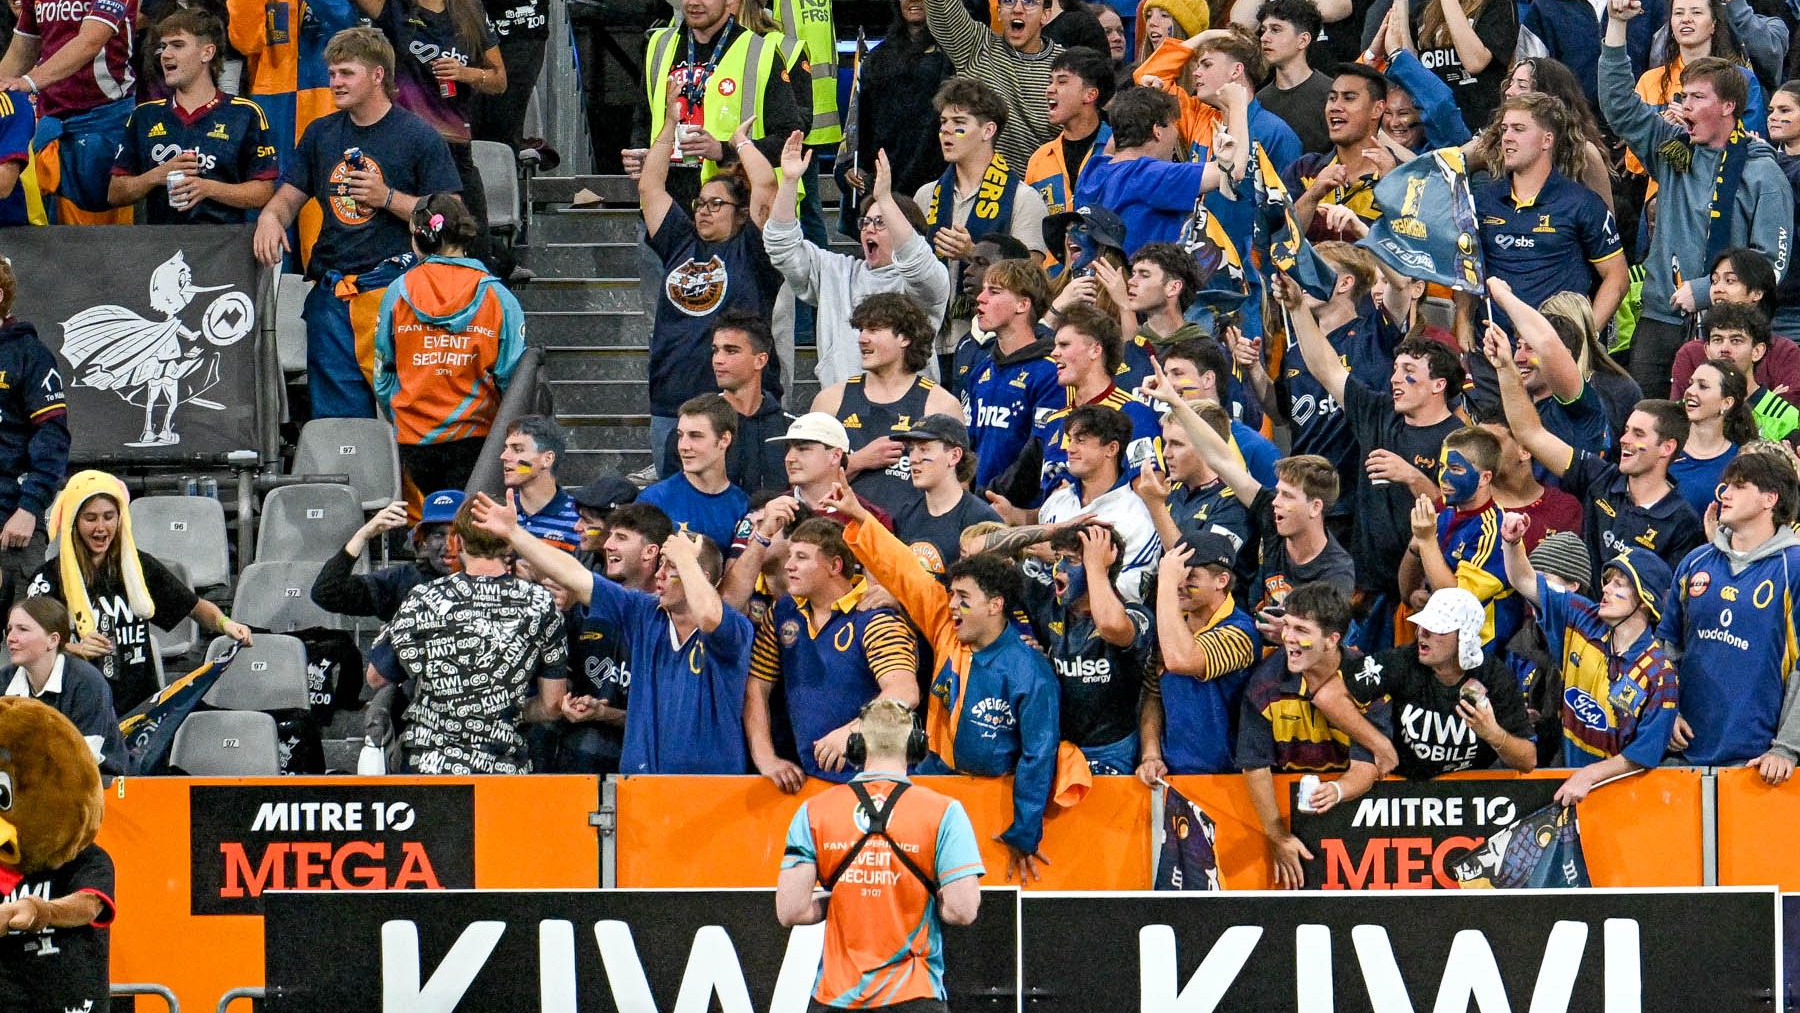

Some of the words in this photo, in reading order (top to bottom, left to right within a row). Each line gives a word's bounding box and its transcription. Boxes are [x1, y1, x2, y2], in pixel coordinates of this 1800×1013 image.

[526, 13, 546, 28] ZOO
[1515, 235, 1535, 248] sbs
[398, 323, 422, 334] FAN
[424, 336, 471, 350] EVENT
[412, 351, 477, 368] SECURITY
[977, 397, 1011, 429] bnz
[1318, 393, 1339, 416] sb
[885, 468, 911, 481] energy
[912, 545, 943, 571] EIGHT'S
[472, 583, 500, 595] KIWI
[1697, 628, 1750, 651] vodafone
[610, 661, 632, 688] sb
[1054, 655, 1111, 678] pulse
[431, 674, 462, 693] KIWI
[1083, 673, 1112, 684] energy
[971, 697, 1016, 726] SPEIGHT'S
[1572, 693, 1603, 726] Ford
[251, 802, 363, 832] MITRE
[371, 801, 416, 832] 10
[1352, 797, 1464, 827] MITRE
[1473, 795, 1517, 826] 10
[823, 840, 847, 853] FAN
[220, 841, 446, 898] MEGA
[1320, 837, 1488, 890] MEG
[837, 869, 902, 886] SECURITY
[861, 887, 882, 897] 3107
[381, 919, 828, 1013] KIW
